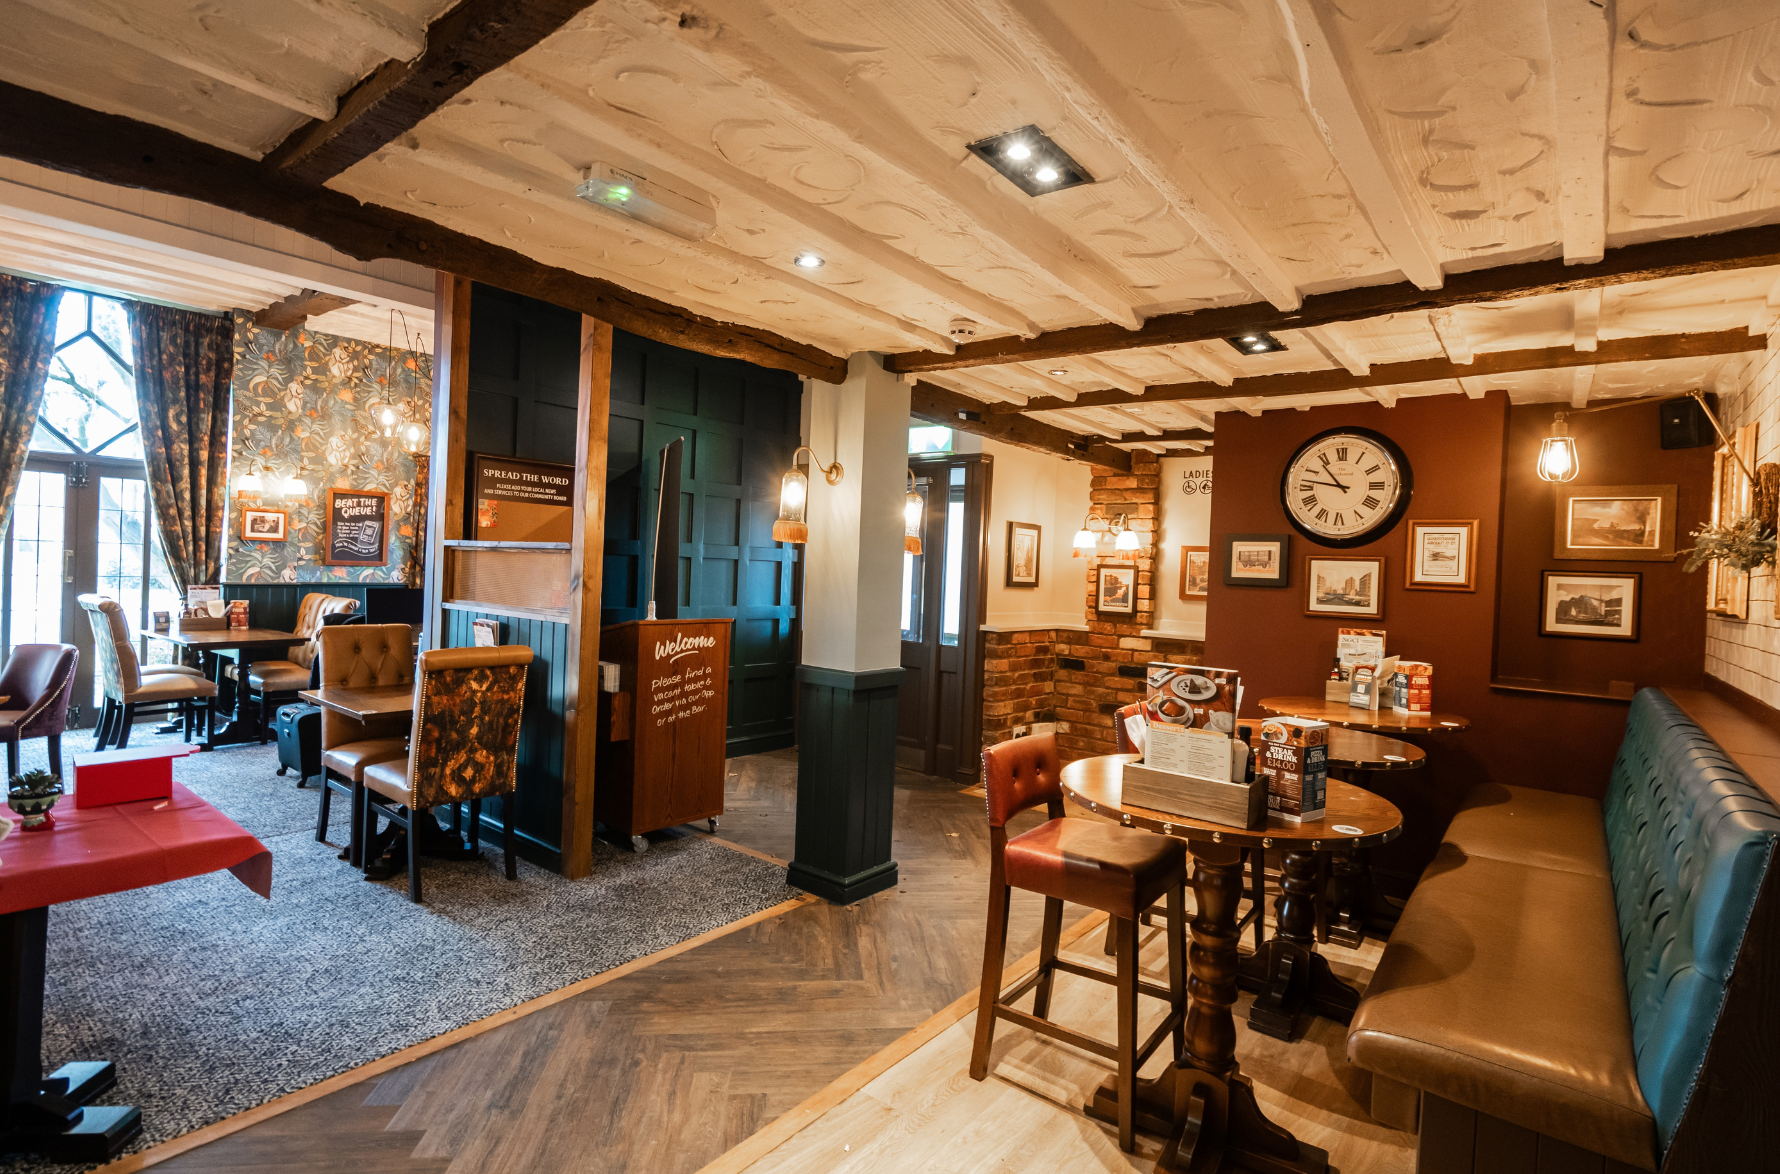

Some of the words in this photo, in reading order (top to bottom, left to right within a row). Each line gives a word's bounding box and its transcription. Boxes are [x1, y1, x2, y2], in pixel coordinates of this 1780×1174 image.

[1336, 448, 1348, 462] XII
[483, 468, 520, 480] SPREAD
[522, 473, 539, 482] THE
[542, 476, 569, 485] WORD
[1368, 481, 1385, 491] III
[335, 498, 358, 508] BEAT
[360, 498, 378, 507] THE
[342, 505, 377, 519] QUEUE!
[655, 632, 716, 660] Welcome
[685, 667, 704, 681] find
[654, 687, 681, 702] vacant
[684, 680, 705, 691] table
[675, 698, 686, 706] via
[688, 693, 700, 703] our
[702, 689, 714, 698] app
[668, 715, 676, 723] at
[678, 710, 690, 719] the
[1153, 722, 1184, 732] Desserts
[1270, 746, 1293, 756] STEAK
[1273, 752, 1297, 763] DRINK
[1267, 758, 1295, 771] £14.00
